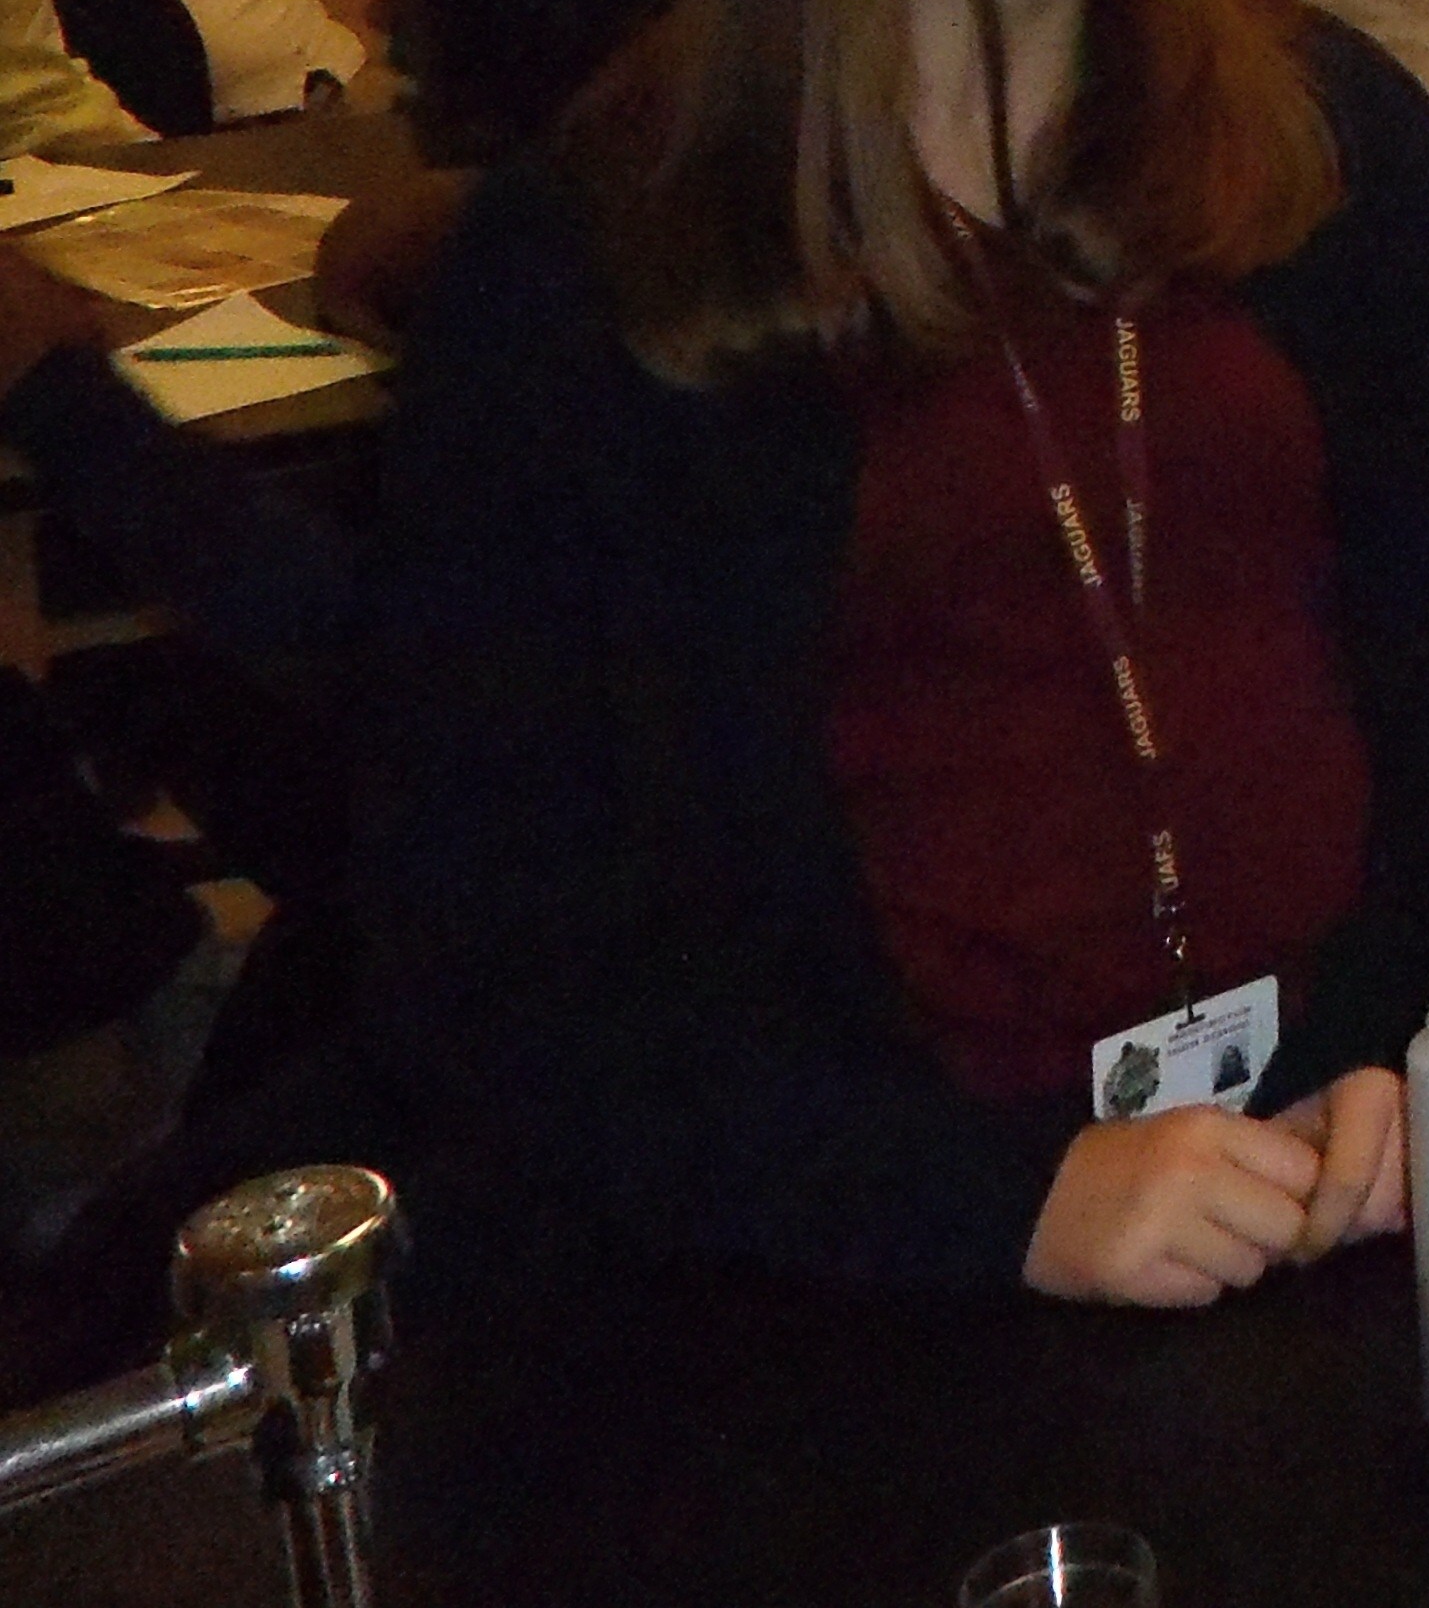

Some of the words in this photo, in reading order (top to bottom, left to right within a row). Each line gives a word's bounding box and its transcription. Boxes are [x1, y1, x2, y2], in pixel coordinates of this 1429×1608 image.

[1114, 316, 1142, 423] JAGUARS
[1051, 482, 1105, 589] JAGUARS
[1112, 654, 1157, 760] JAGUARS
